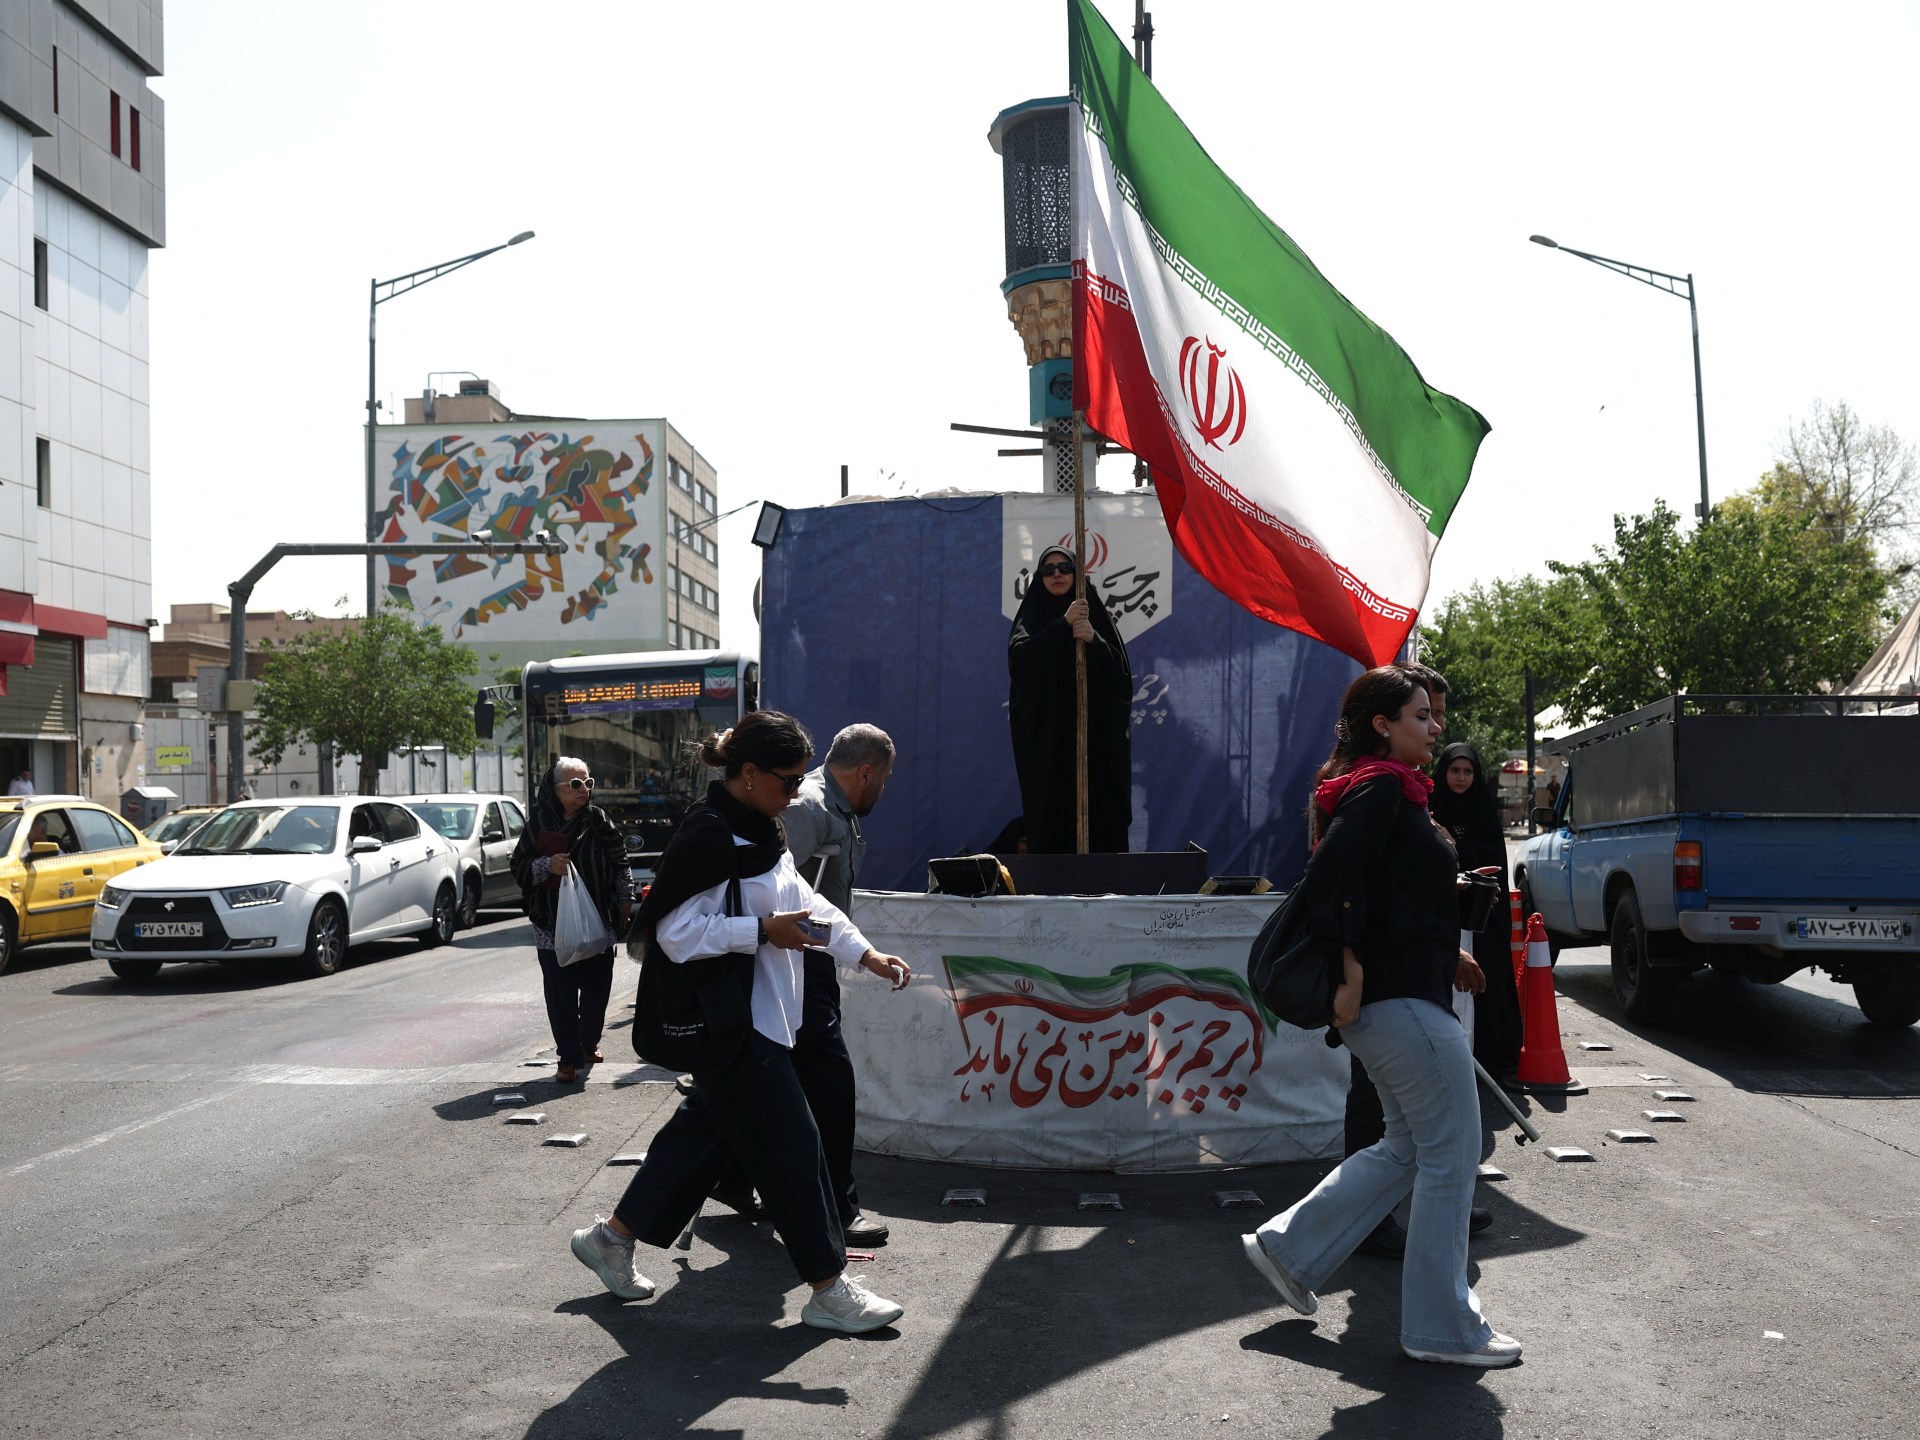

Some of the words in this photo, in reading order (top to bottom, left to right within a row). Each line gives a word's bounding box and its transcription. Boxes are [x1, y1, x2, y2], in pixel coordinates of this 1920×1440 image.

[1143, 920, 1165, 936] ایران
[1058, 1011, 1165, 1109] زمین
[1175, 1020, 1249, 1114] پرچم
